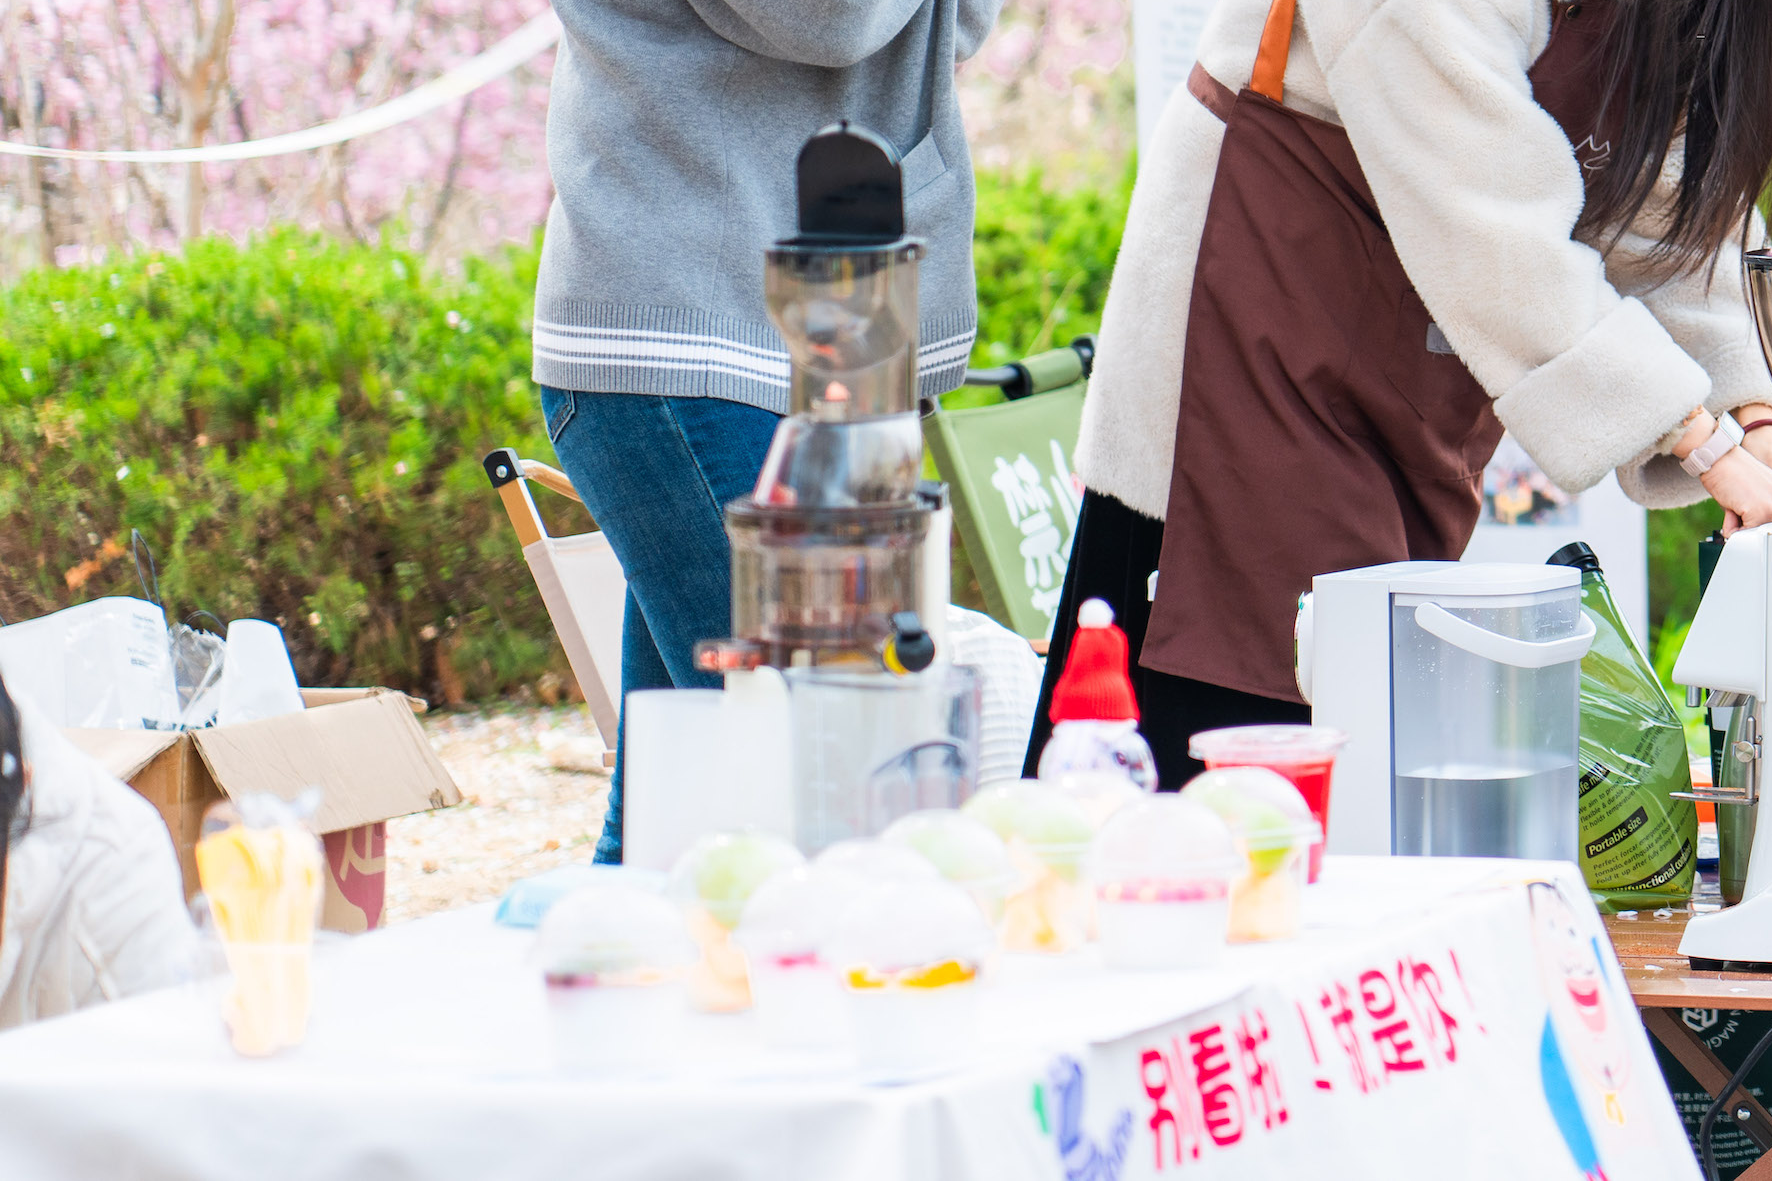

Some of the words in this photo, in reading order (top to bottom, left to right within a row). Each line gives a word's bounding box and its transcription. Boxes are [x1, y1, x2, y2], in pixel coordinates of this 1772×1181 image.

[1588, 798, 1598, 808] aim
[1580, 807, 1601, 823] flexible
[1590, 815, 1606, 829] holds
[1588, 828, 1628, 856] Portable
[1628, 816, 1642, 832] size
[1593, 855, 1620, 871] Perfect
[1596, 874, 1612, 885] Fold
[1621, 865, 1631, 878] up
[1632, 858, 1649, 872] after
[1648, 848, 1660, 864] fully
[1703, 1020, 1739, 1050] MAGI
